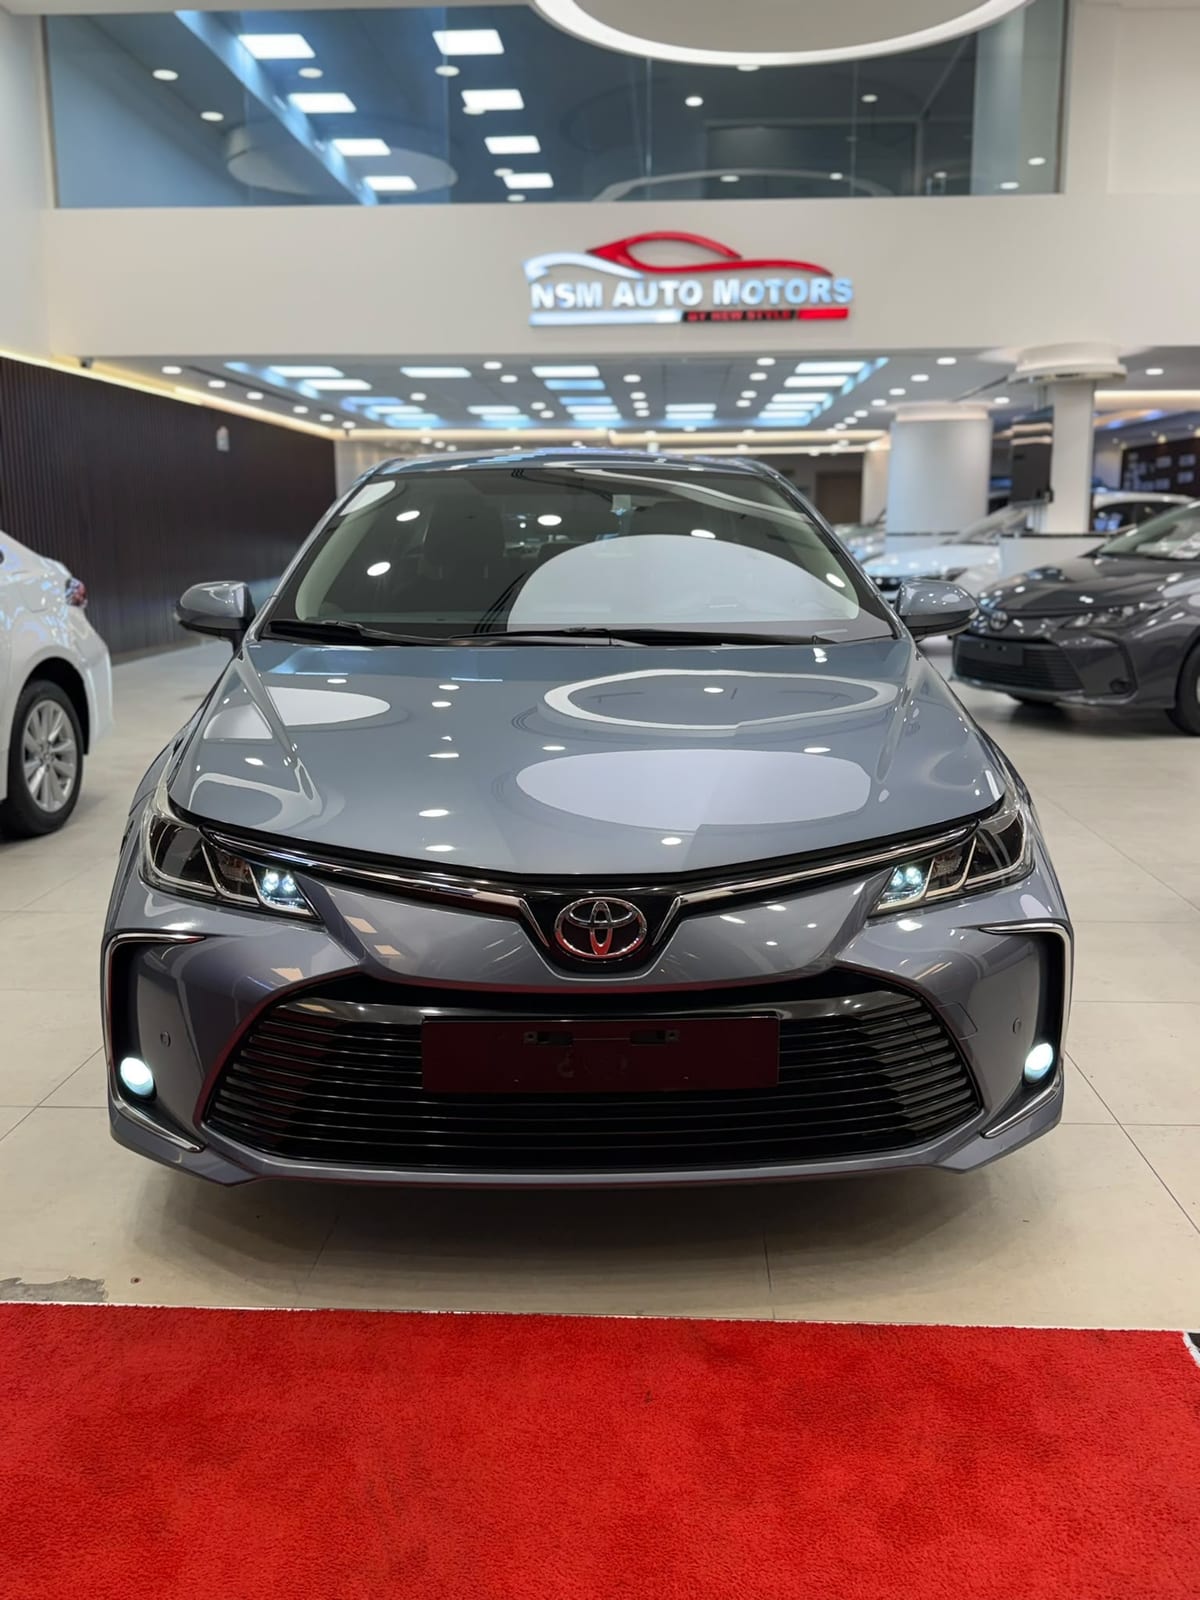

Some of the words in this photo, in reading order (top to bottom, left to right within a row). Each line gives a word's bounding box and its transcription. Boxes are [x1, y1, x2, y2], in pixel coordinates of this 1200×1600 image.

[531, 282, 602, 308] NSM
[612, 279, 703, 307] AUTO
[713, 277, 853, 304] MOTORS
